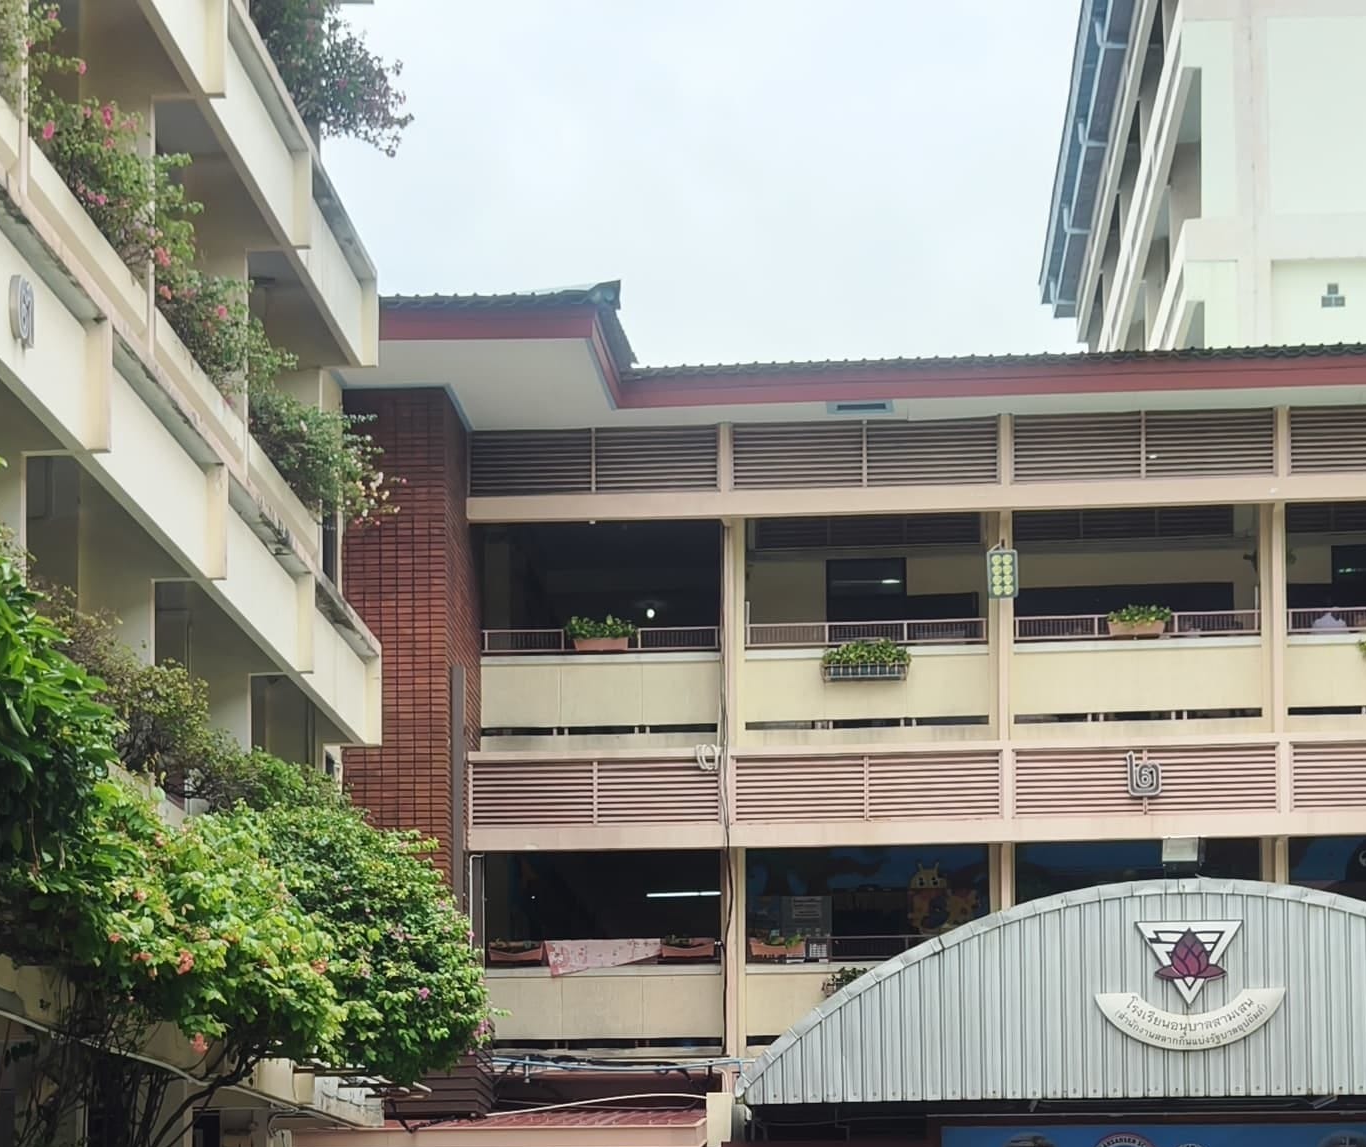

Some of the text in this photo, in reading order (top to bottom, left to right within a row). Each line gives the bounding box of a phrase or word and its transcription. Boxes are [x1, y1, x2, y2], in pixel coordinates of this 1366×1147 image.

[1125, 995, 1255, 1036] โรงเรียนอนุบาลสามเสน
